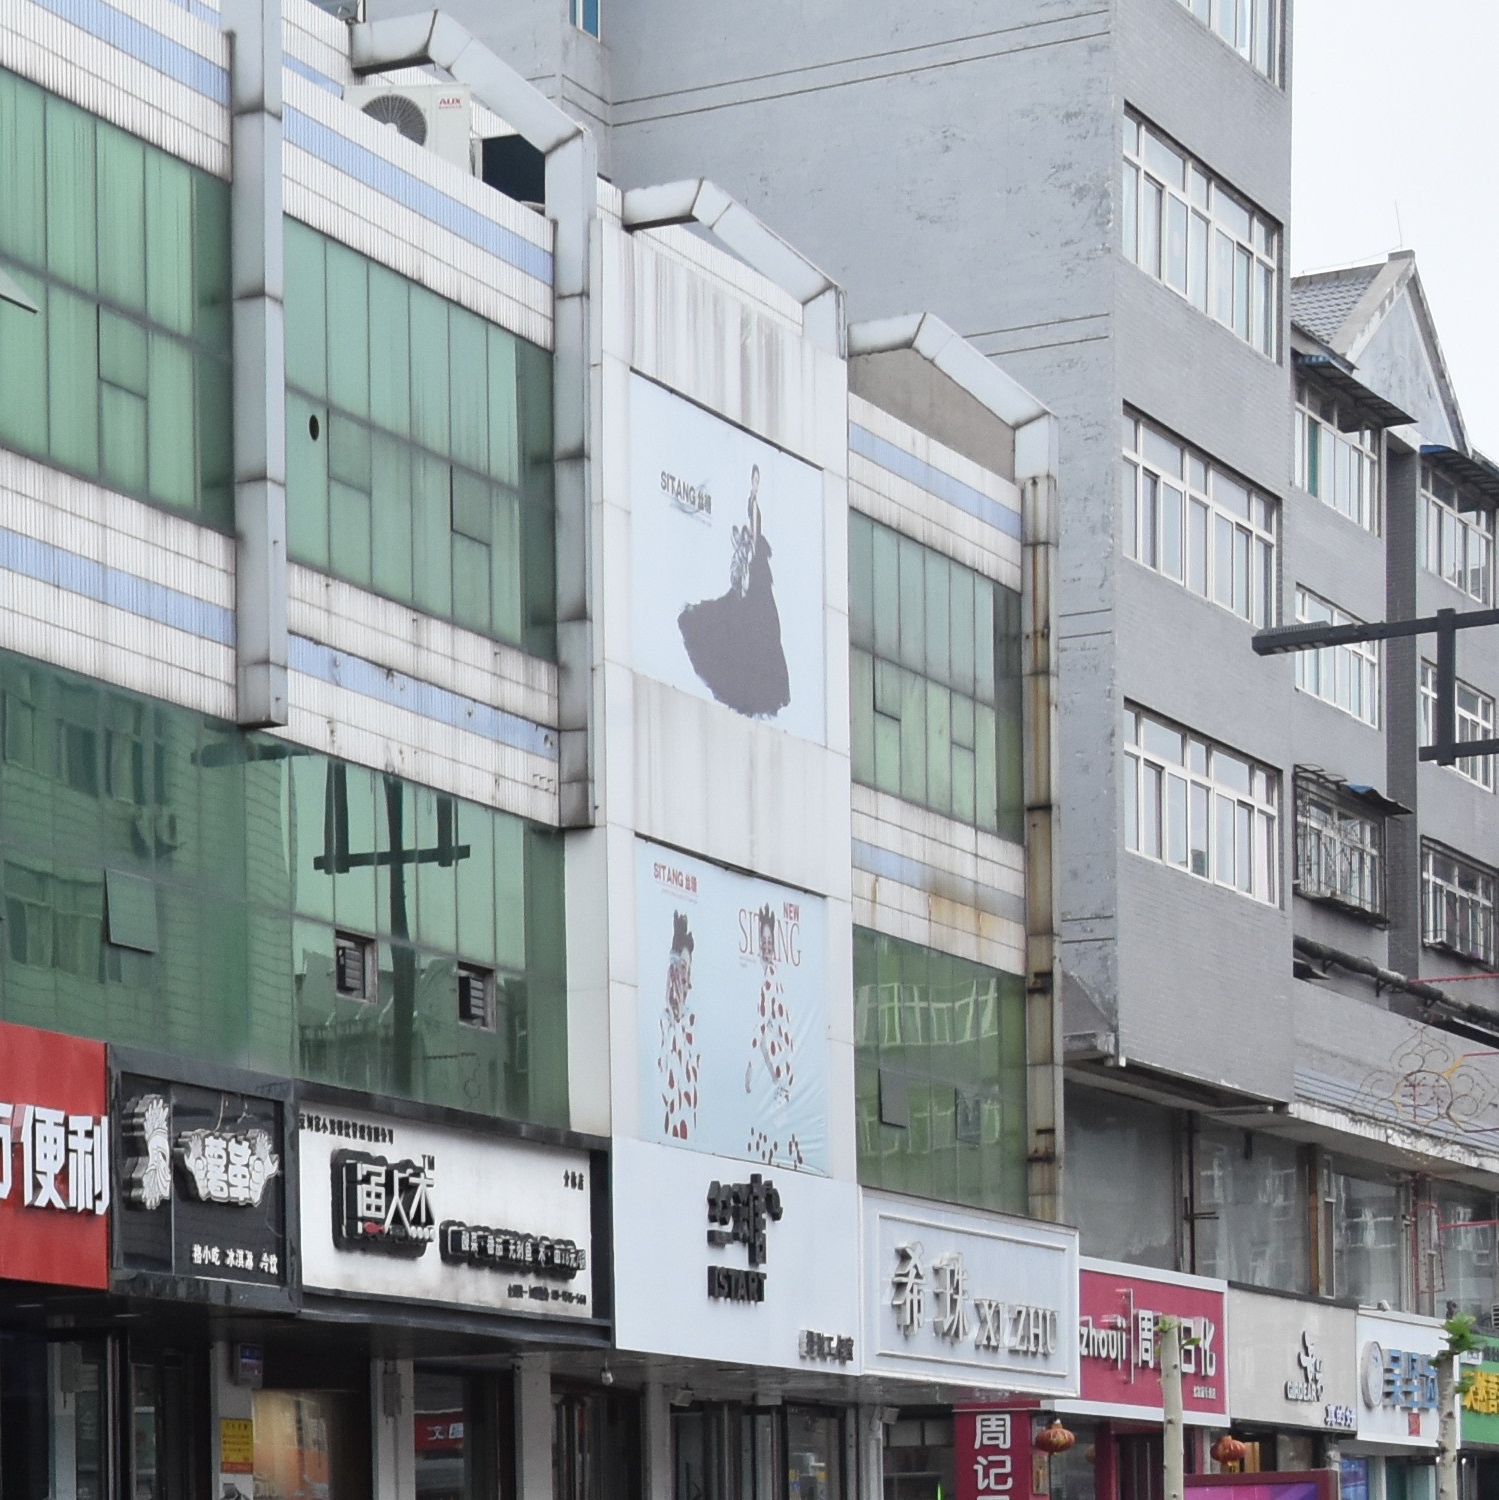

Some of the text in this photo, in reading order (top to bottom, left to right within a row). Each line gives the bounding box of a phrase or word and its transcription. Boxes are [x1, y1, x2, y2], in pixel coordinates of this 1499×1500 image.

[660, 470, 696, 506] SITANG
[653, 862, 684, 889] SITANG
[782, 902, 800, 922] NEW
[890, 1241, 969, 1343] 希珠
[1138, 1309, 1217, 1378] 周日化
